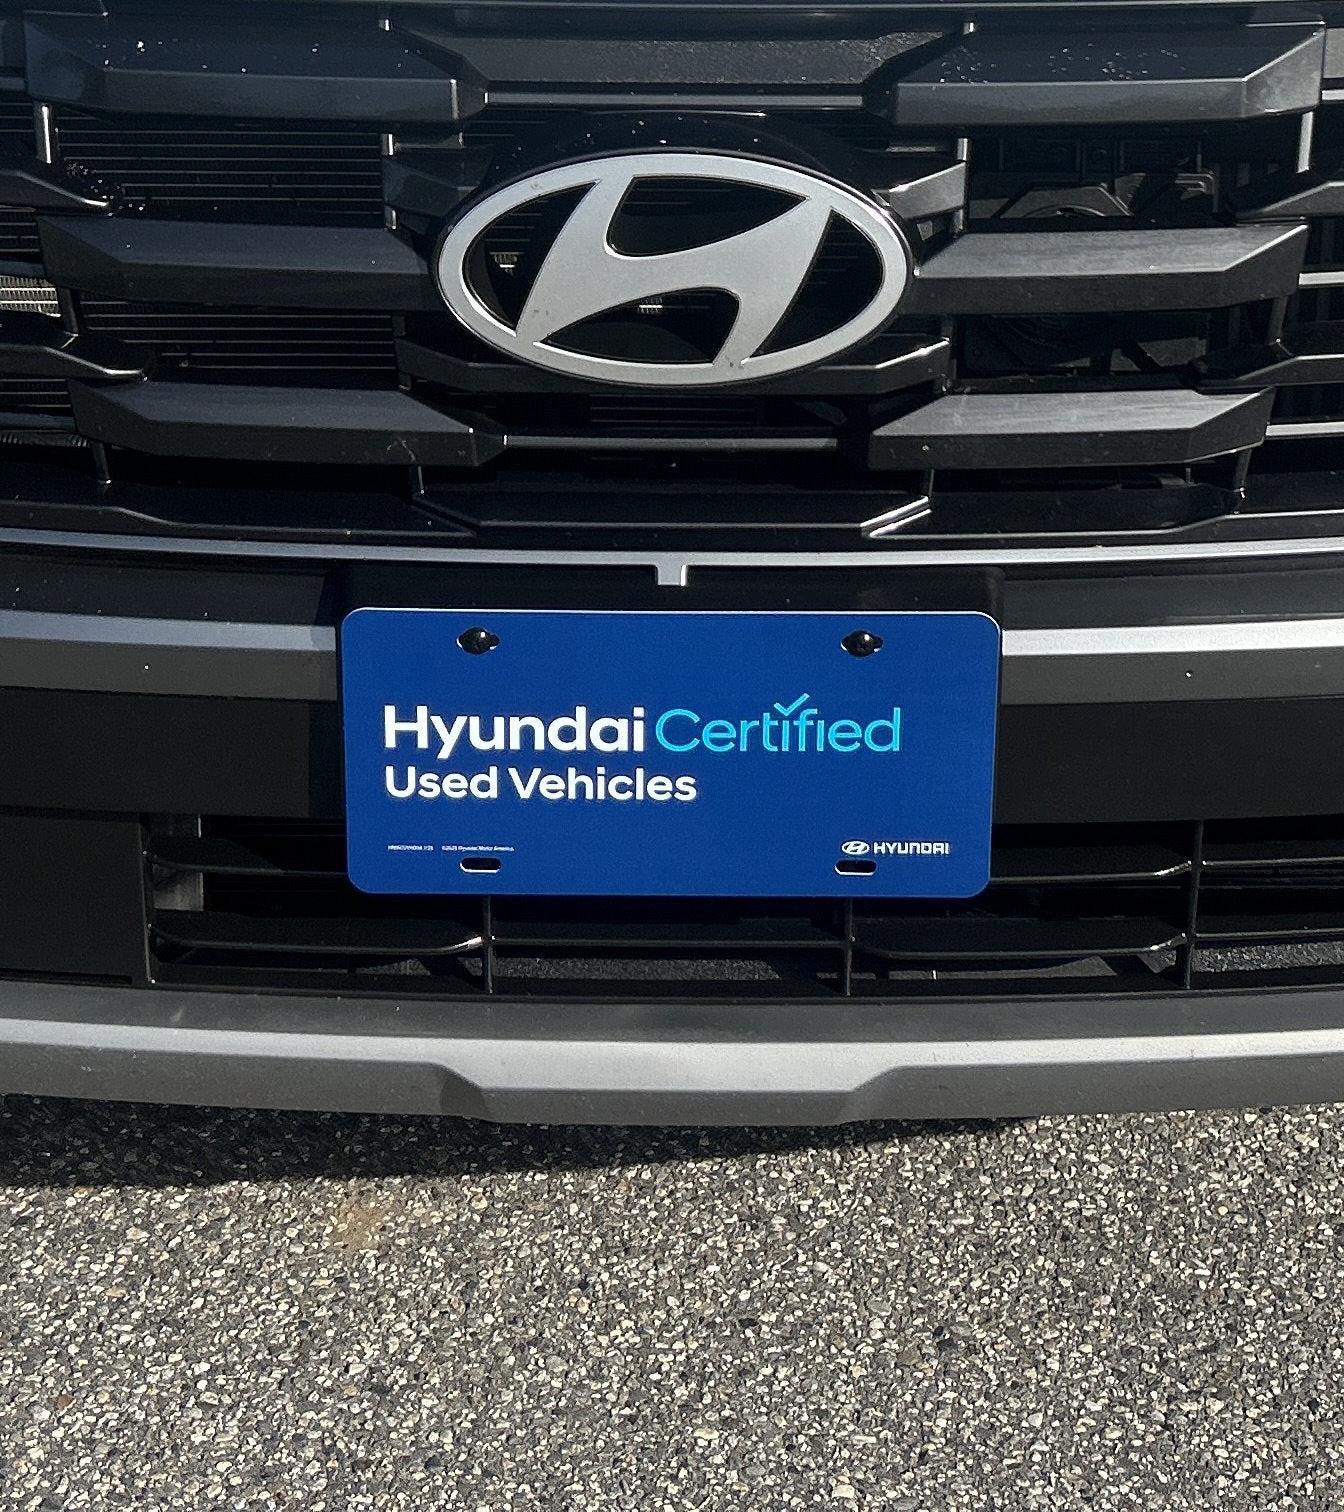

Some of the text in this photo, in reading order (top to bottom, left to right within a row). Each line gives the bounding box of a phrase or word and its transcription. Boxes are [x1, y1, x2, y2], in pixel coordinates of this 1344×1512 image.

[384, 694, 902, 759] Hyundai Certified
[385, 765, 698, 802] Used Vehicles
[873, 841, 950, 855] HYUNDAI
